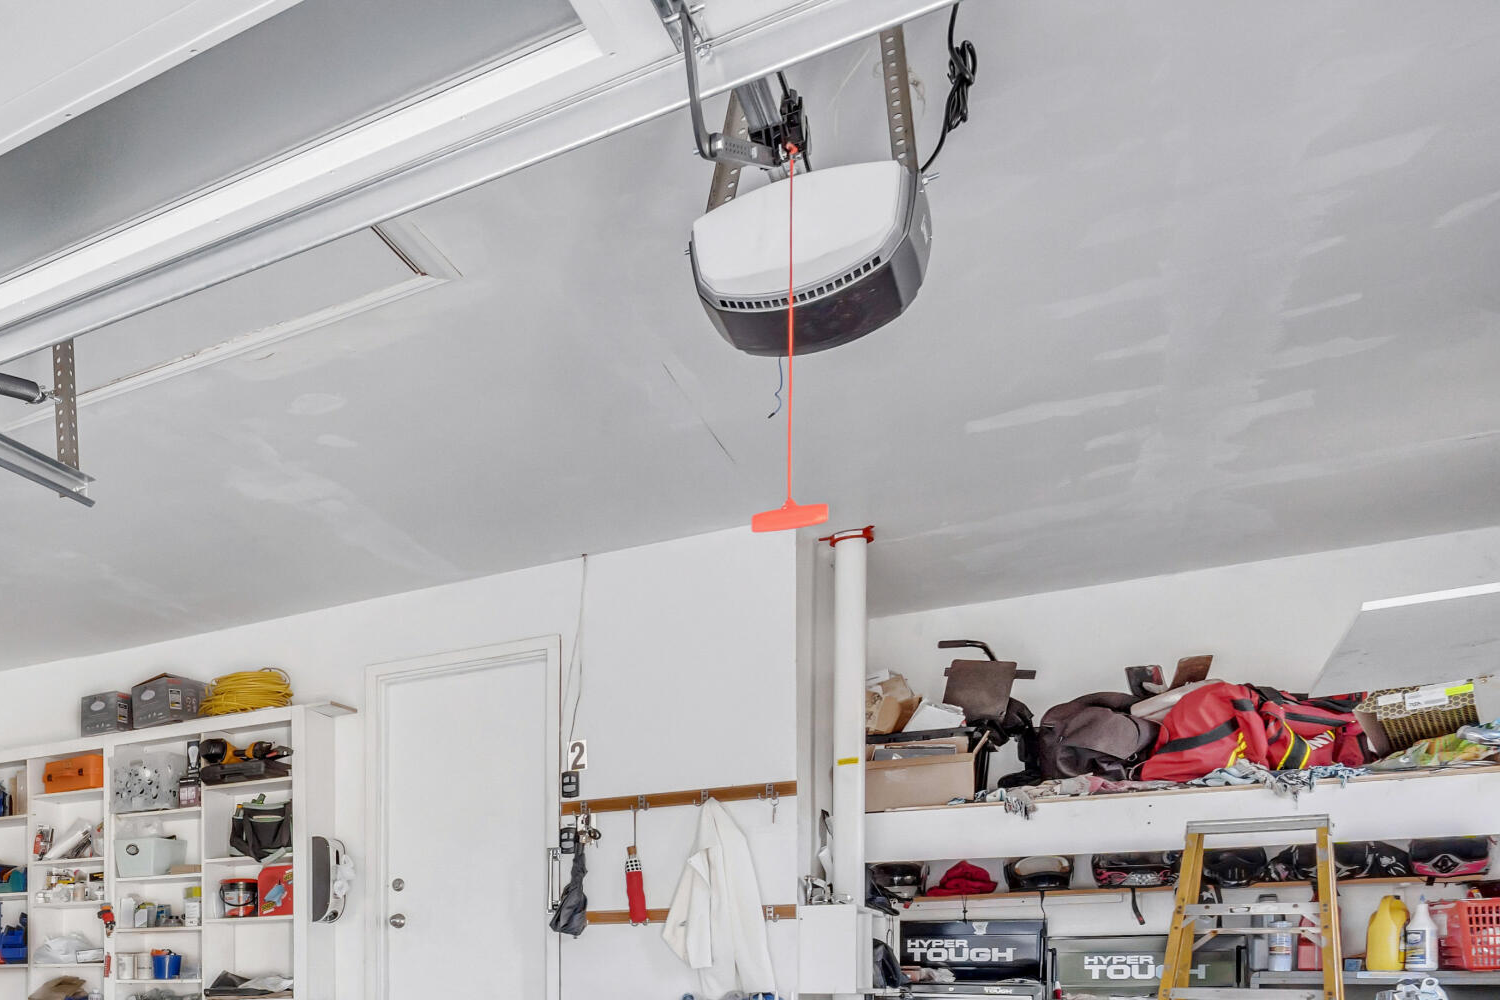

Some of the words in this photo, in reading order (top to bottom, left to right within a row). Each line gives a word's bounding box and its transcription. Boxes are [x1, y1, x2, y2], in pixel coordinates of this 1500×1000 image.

[570, 741, 586, 770] 2
[907, 939, 968, 948] HYPER
[907, 947, 1014, 962] TOUGH
[1084, 955, 1154, 965] HYPER
[1084, 964, 1206, 980] TOUH
